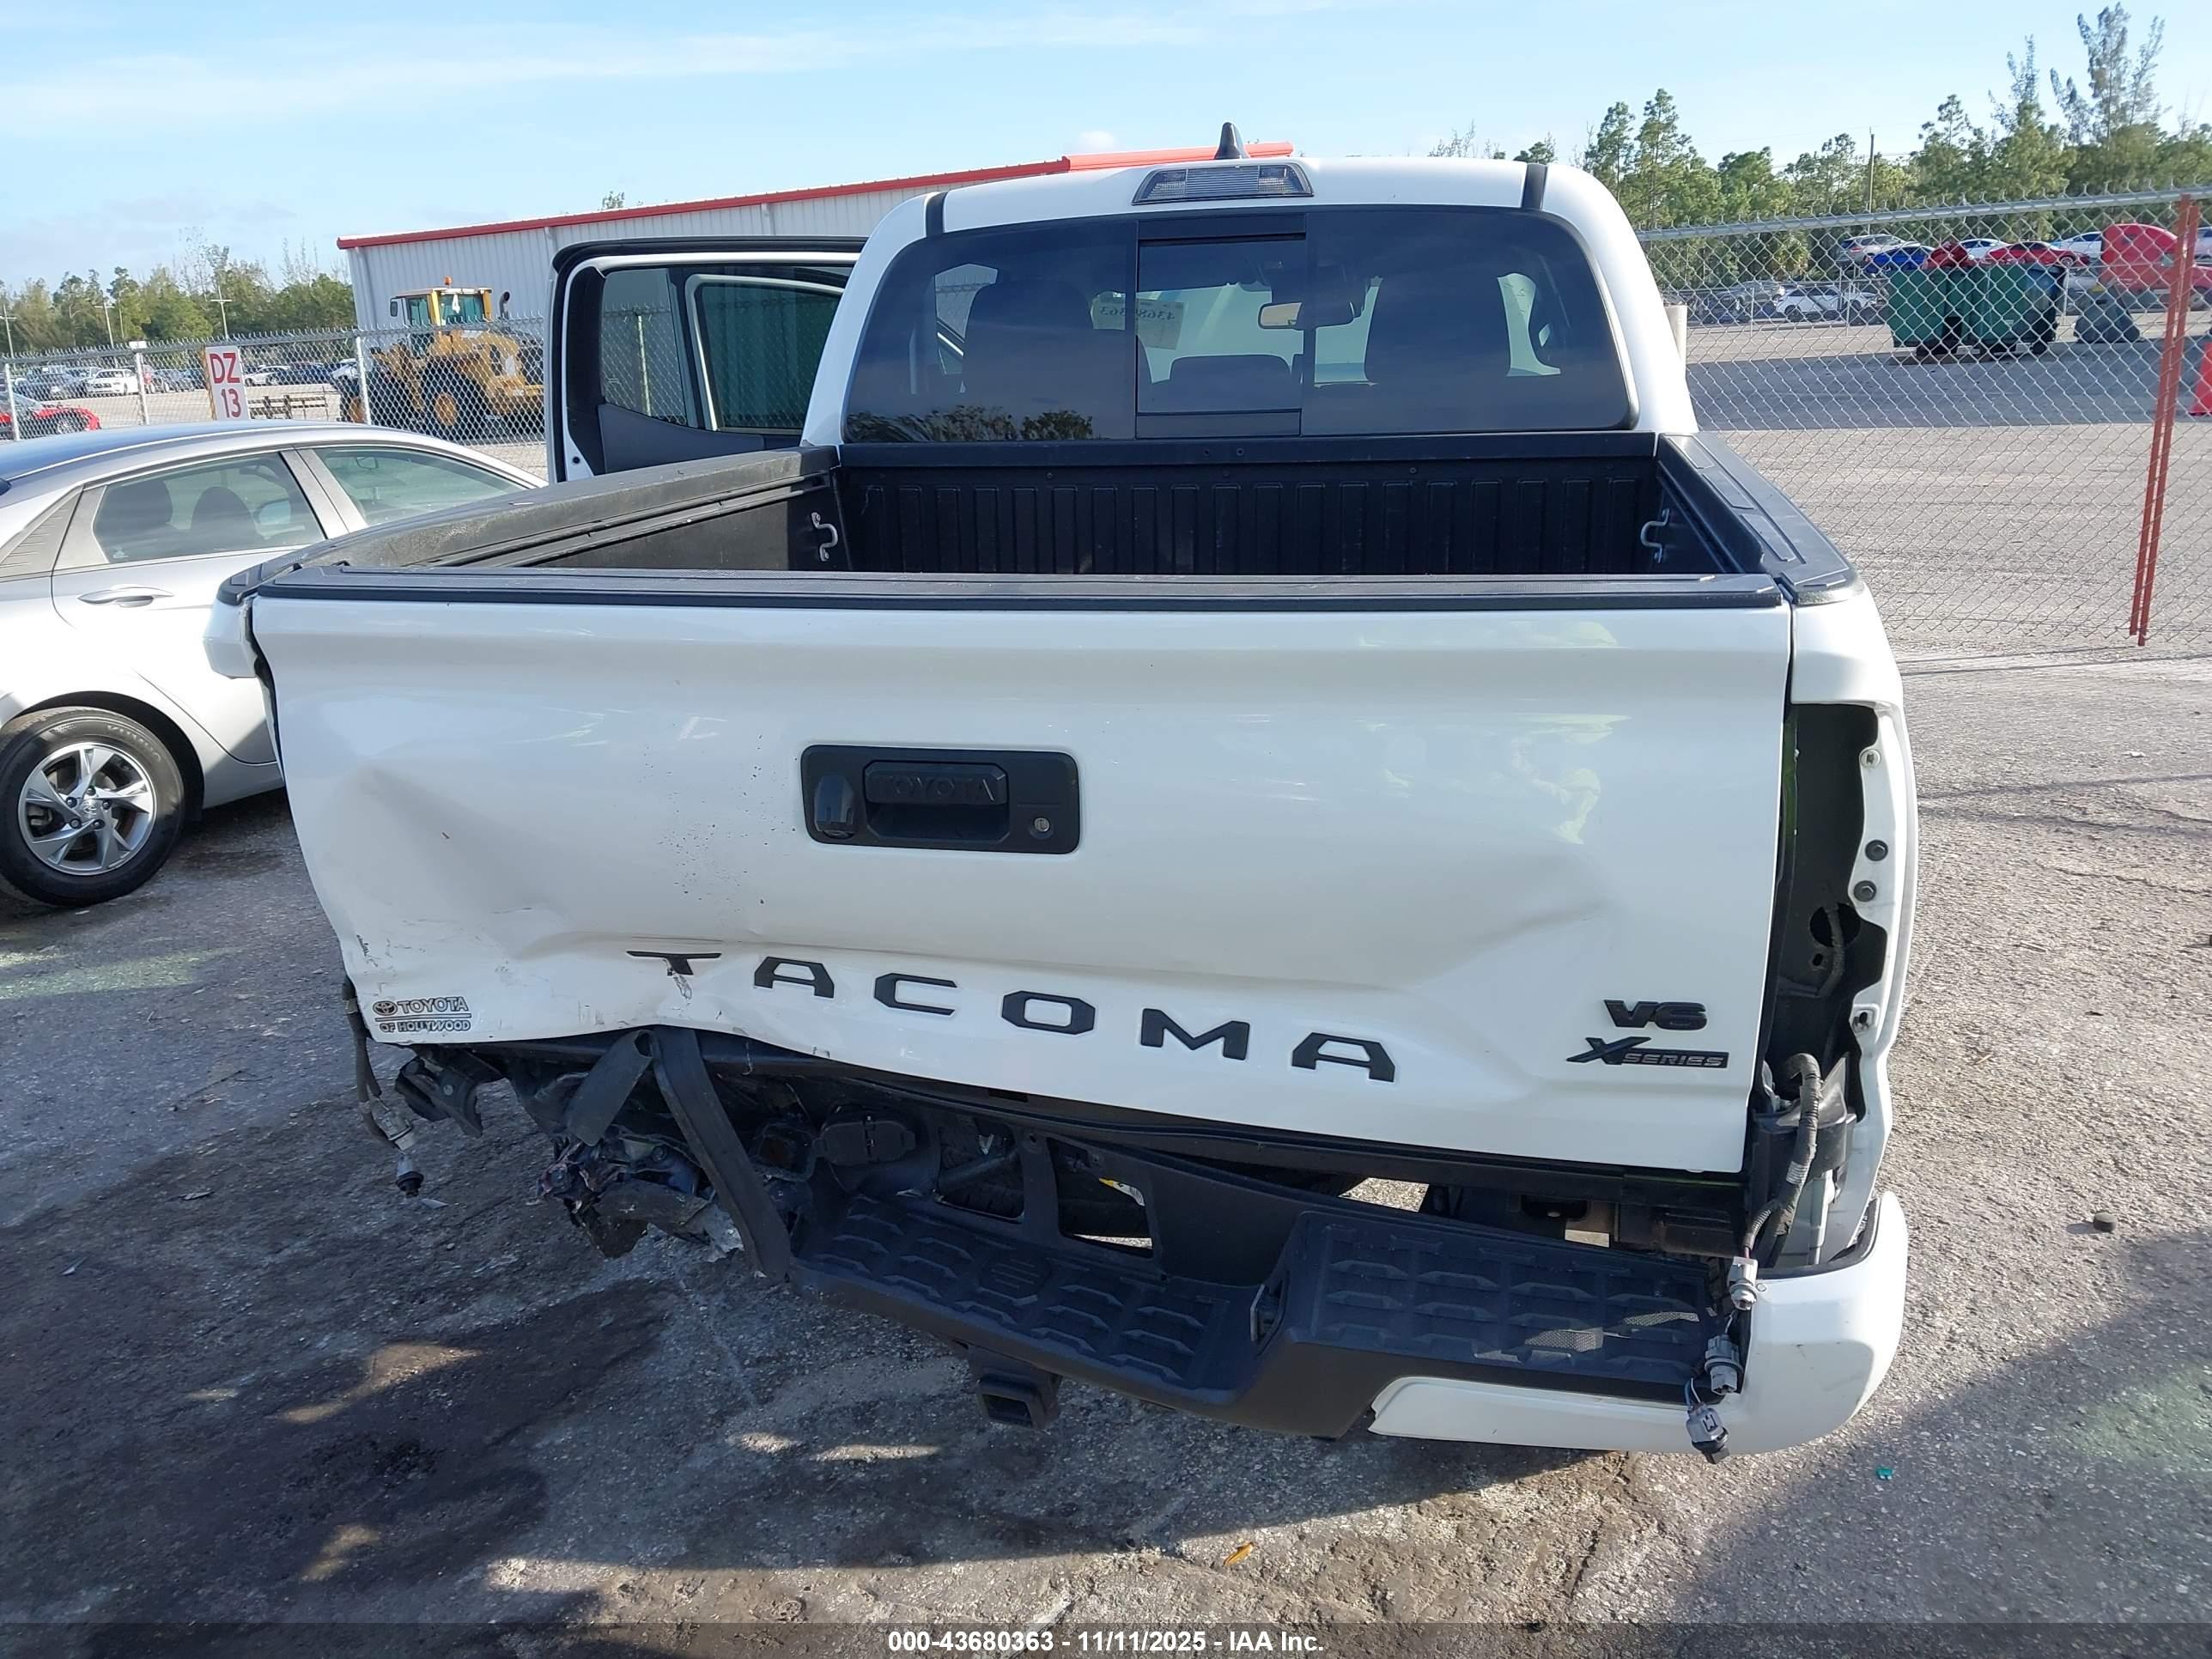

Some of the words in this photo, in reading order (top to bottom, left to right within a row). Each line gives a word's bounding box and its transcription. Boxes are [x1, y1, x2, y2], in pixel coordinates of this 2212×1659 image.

[210, 353, 240, 384] DZ
[221, 388, 241, 417] 13
[872, 774, 994, 802] TOYOTA
[397, 996, 469, 1013] TOYOTA
[626, 950, 1396, 1084] TACOMA
[1603, 1000, 1708, 1030] V6
[380, 1022, 396, 1033] OF
[398, 1019, 471, 1032] HOLLYWOOD
[1622, 1053, 1724, 1067] SERIES
